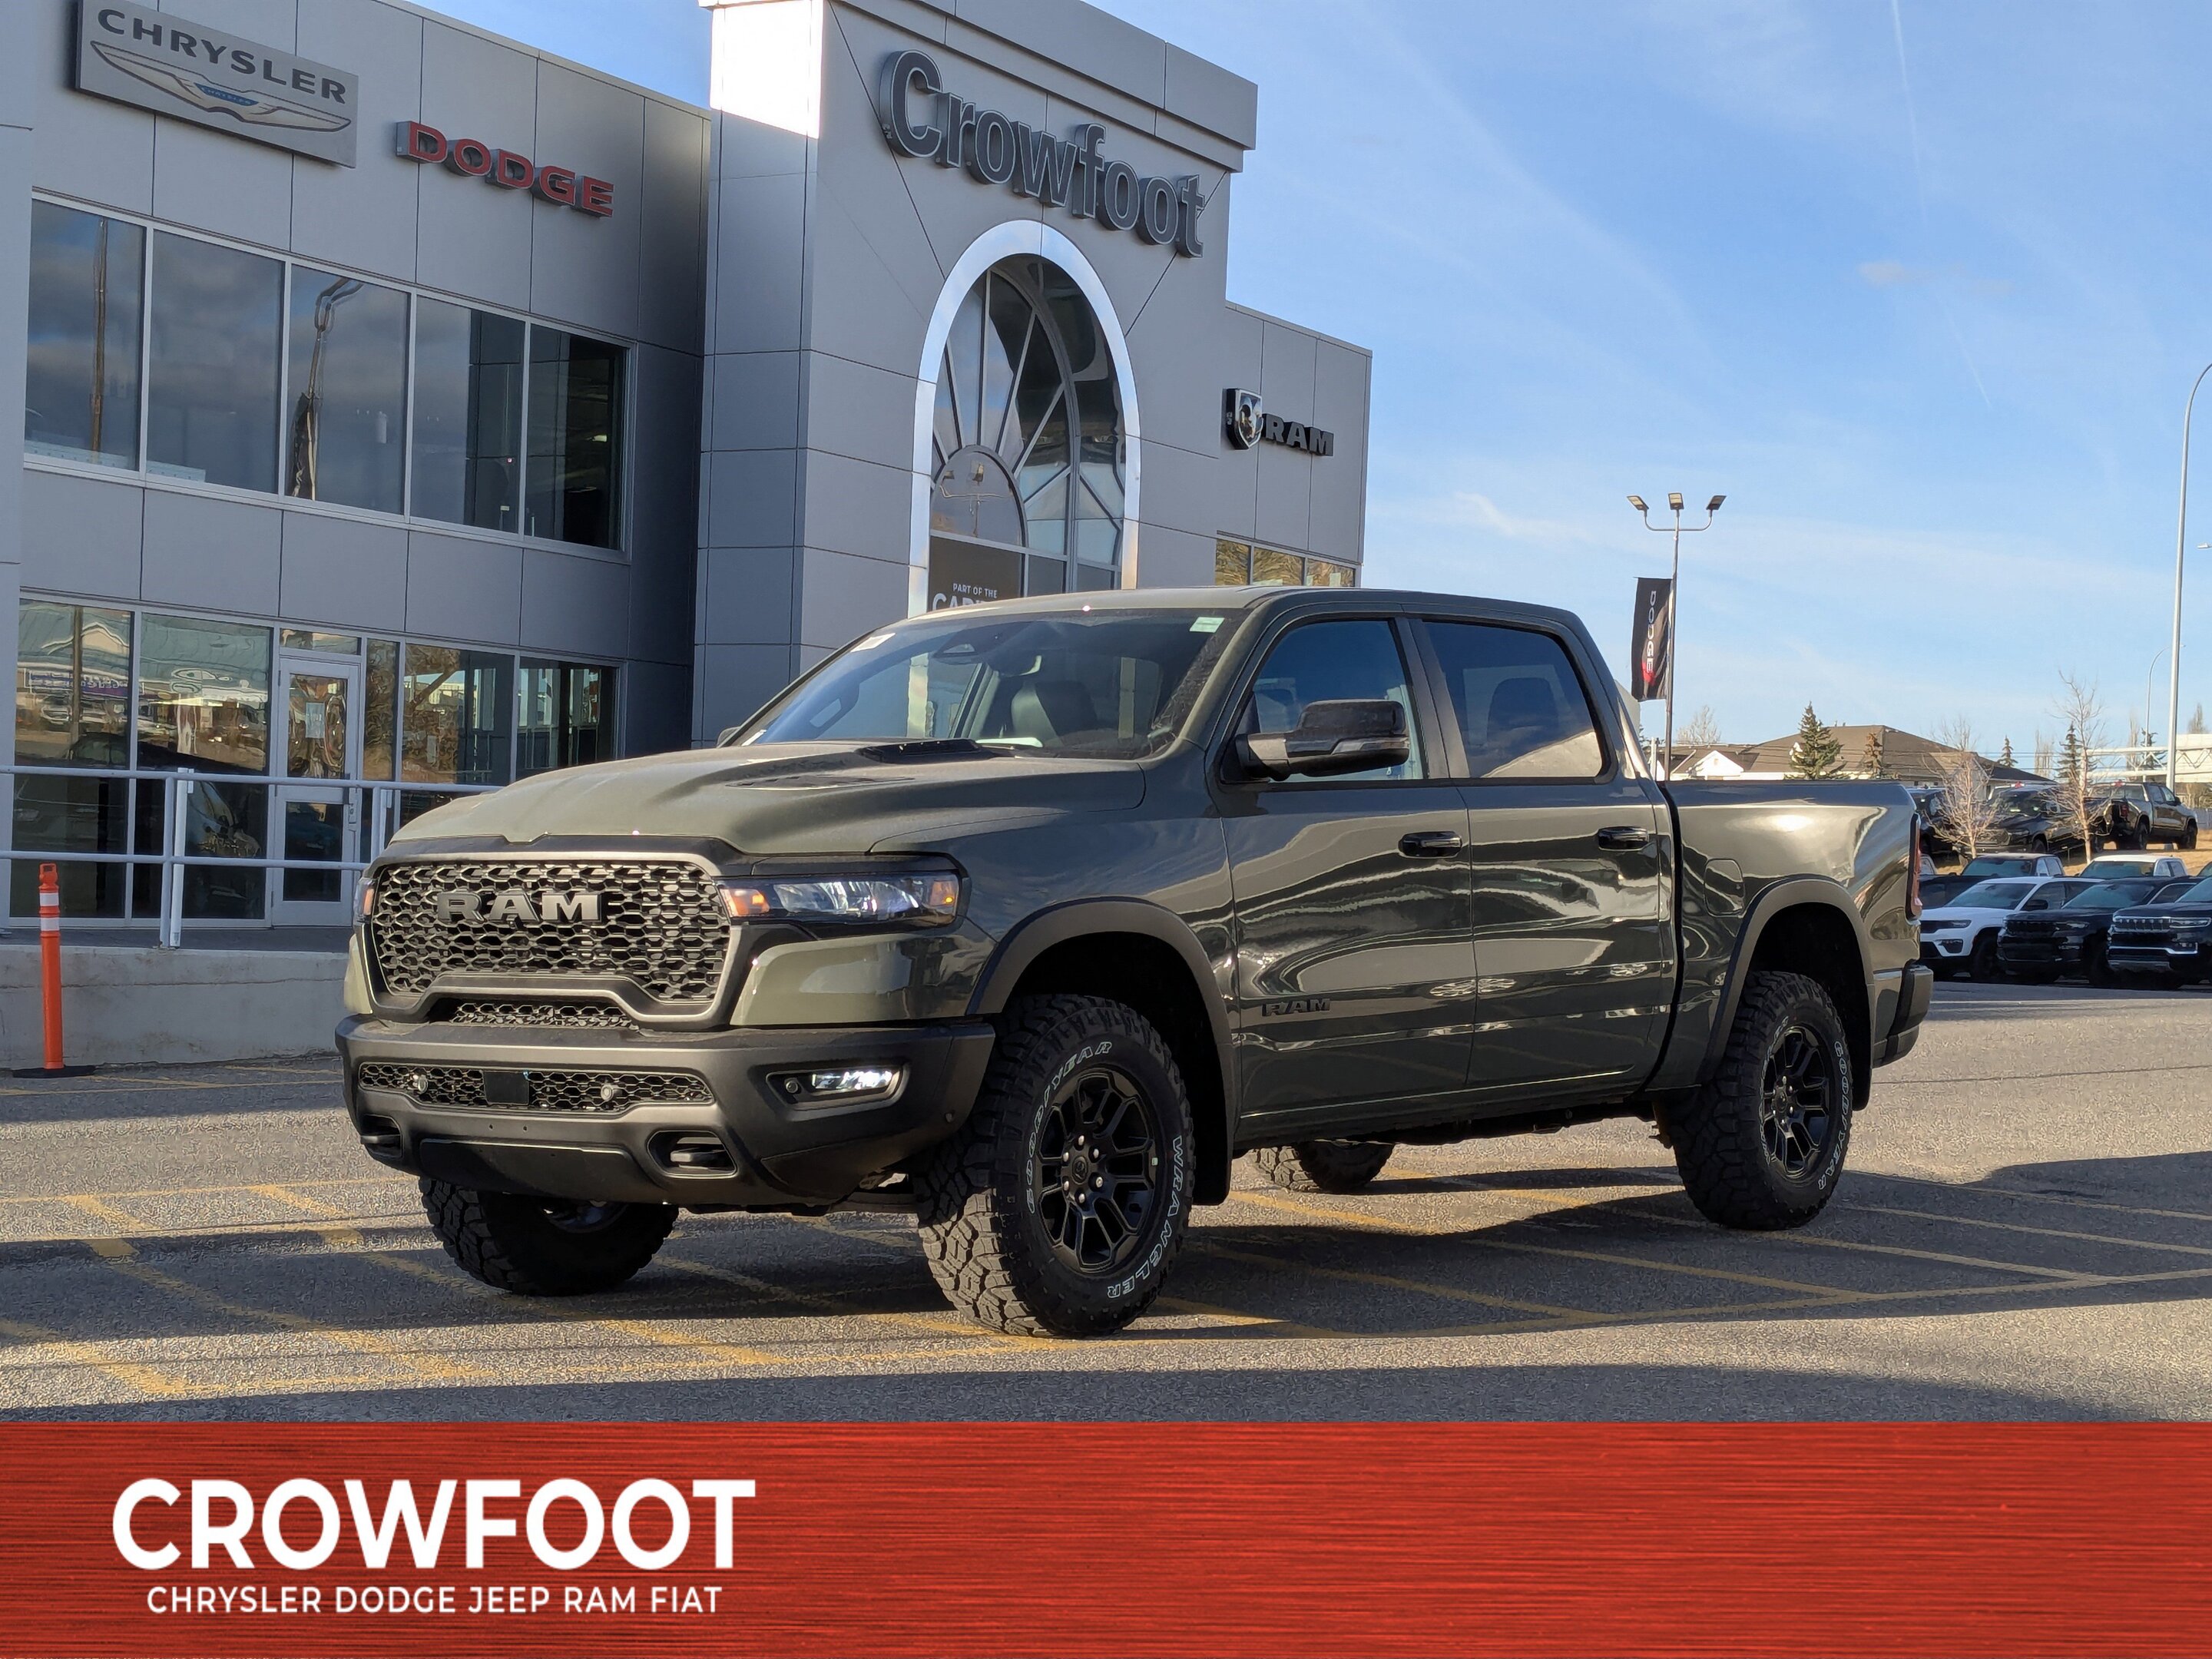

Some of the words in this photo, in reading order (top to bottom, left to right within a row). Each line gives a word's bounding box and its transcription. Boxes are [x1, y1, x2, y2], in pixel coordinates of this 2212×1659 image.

[98, 8, 346, 104] CHRYSLER
[402, 121, 614, 218] DODGE
[881, 49, 1206, 258] Crowfoot
[1263, 413, 1335, 457] RAM
[952, 583, 971, 595] PART
[972, 586, 983, 596] OF
[984, 588, 998, 599] THE
[1646, 590, 1657, 674] DODGE
[437, 892, 603, 922] RAM
[1262, 998, 1331, 1017] RAM
[1026, 1041, 1113, 1214] GOODYEAR
[1107, 1135, 1184, 1299] WRANGLER
